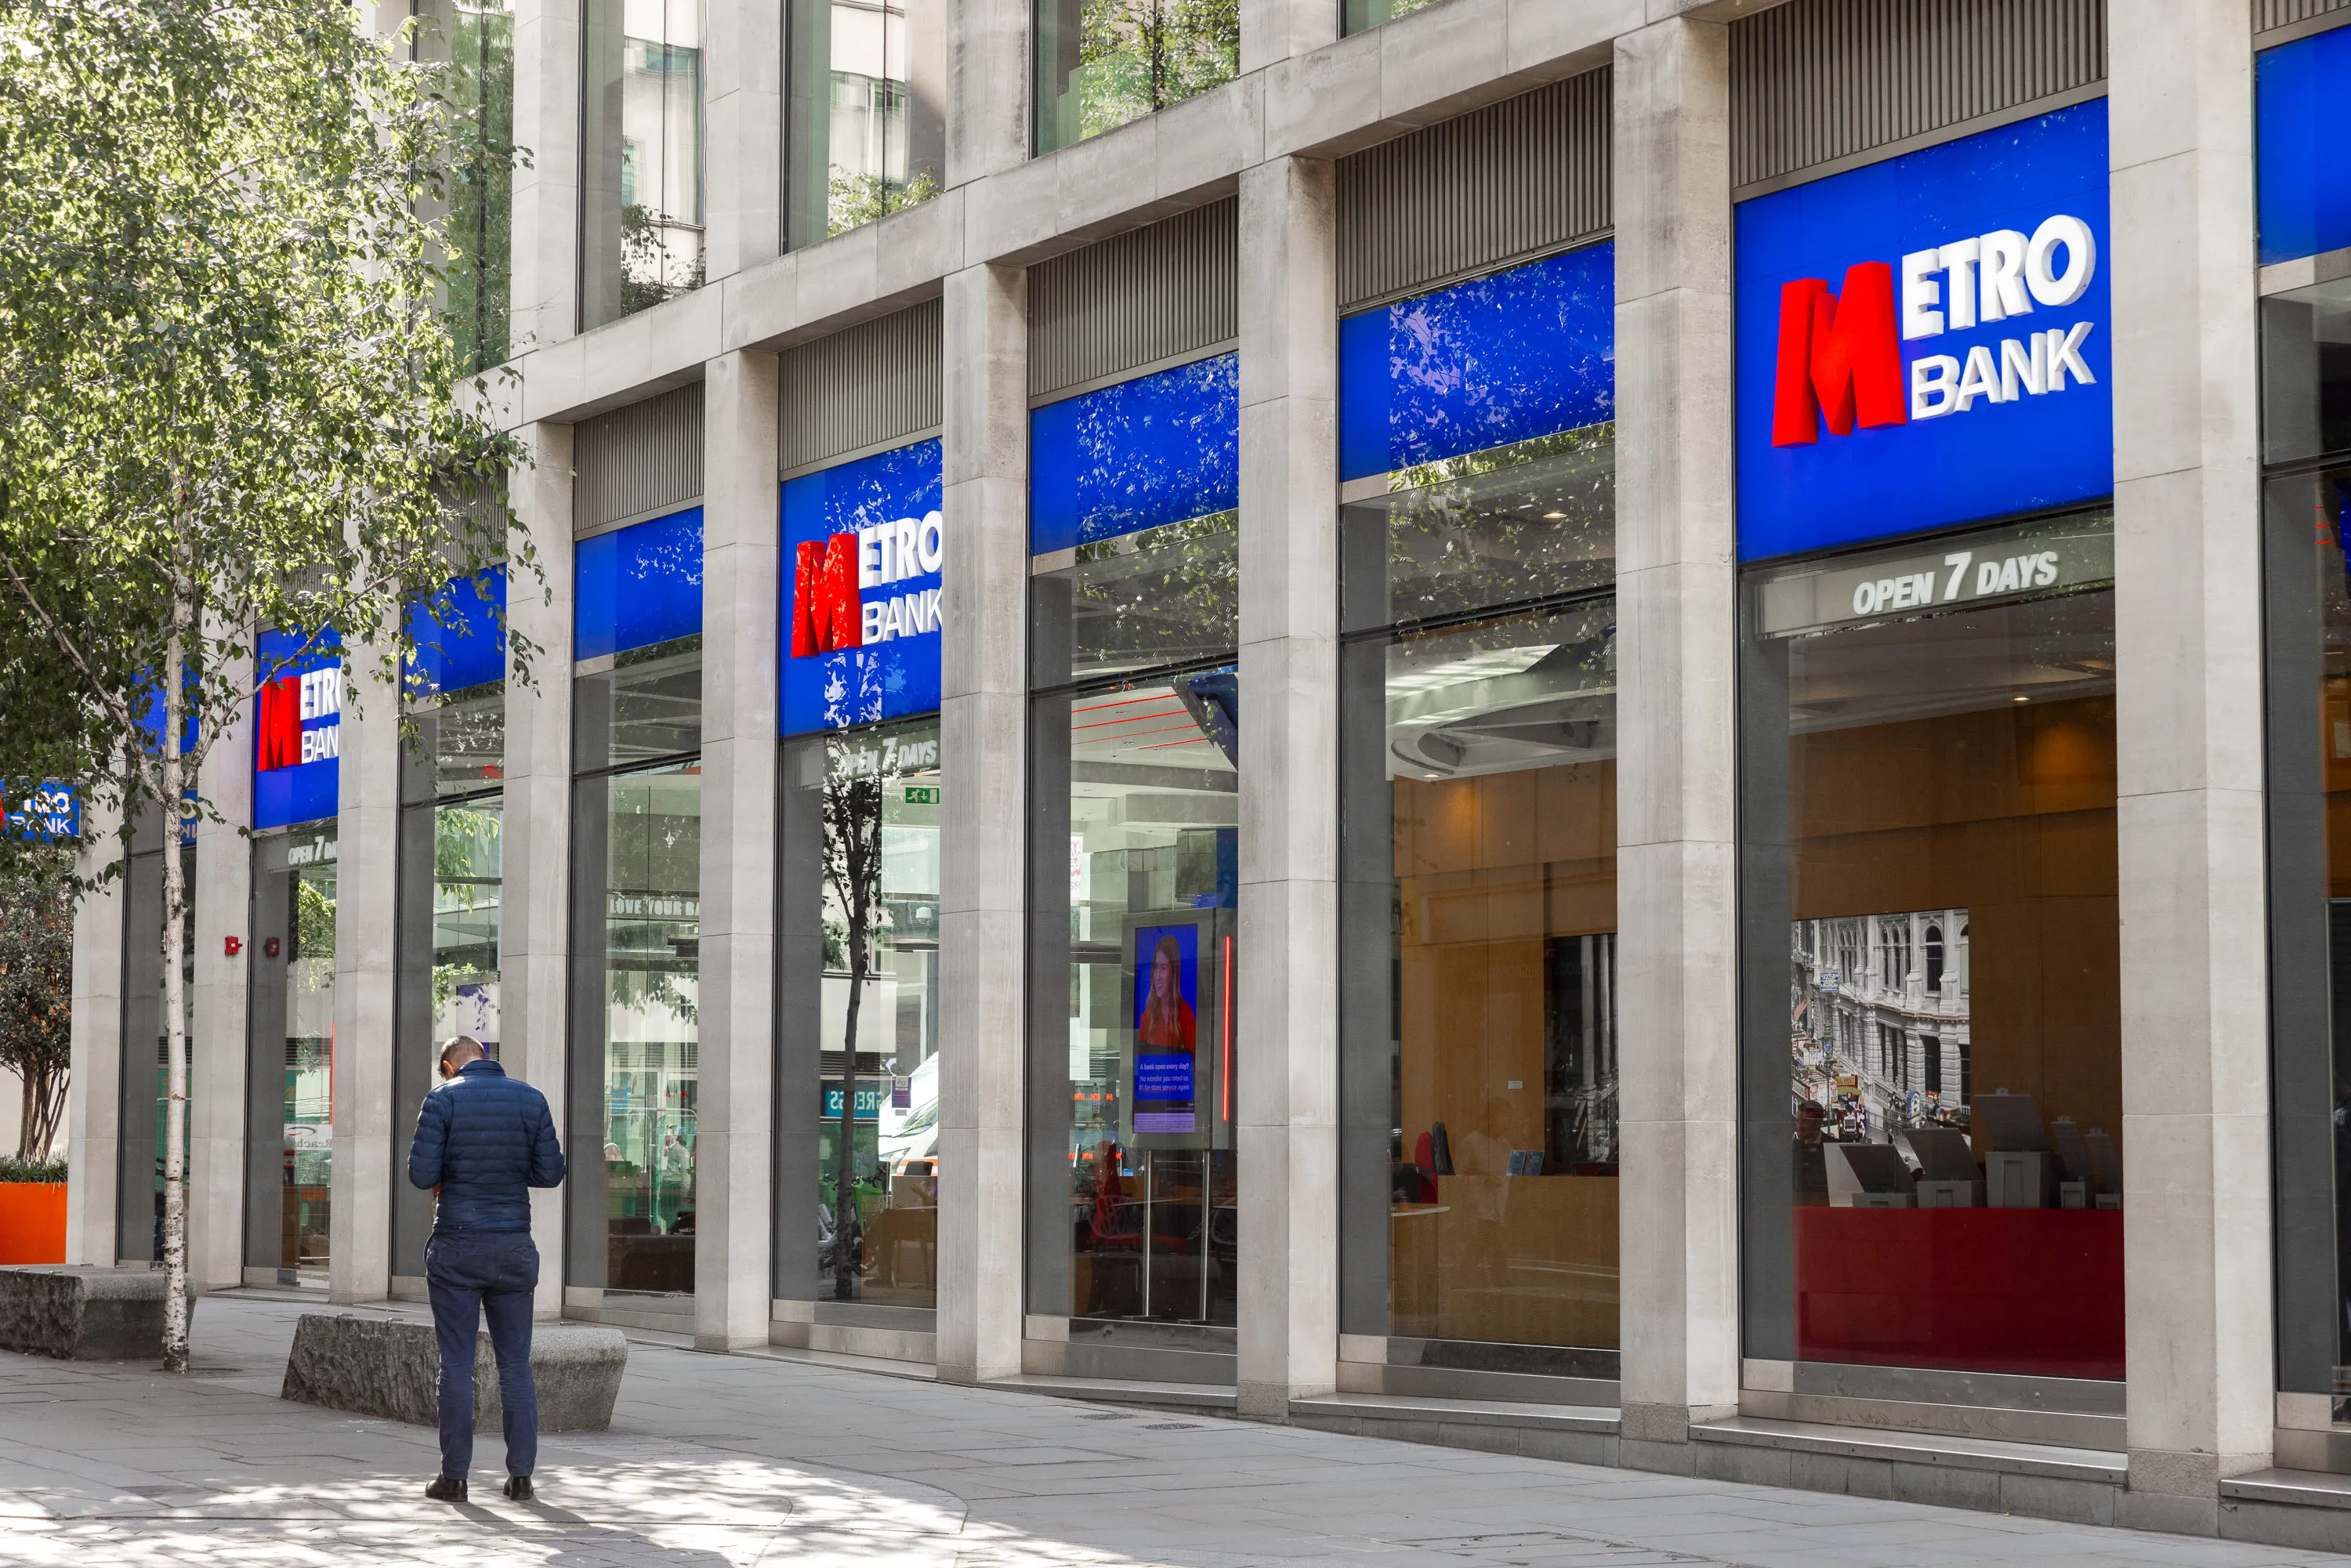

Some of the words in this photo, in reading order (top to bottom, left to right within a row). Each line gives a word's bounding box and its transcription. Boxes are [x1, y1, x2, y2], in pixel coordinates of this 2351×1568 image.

[1772, 214, 2097, 449] METRO
[1911, 321, 2097, 420] BANK
[791, 510, 943, 659] METRO
[1853, 571, 1935, 614] OPEN
[1943, 551, 1972, 601] 7
[1976, 551, 2059, 595] DAYS
[862, 587, 942, 646] BANK
[302, 724, 339, 764] BAN
[882, 737, 898, 770] 7
[897, 740, 937, 768] DAYS
[314, 835, 325, 861] 7
[609, 897, 642, 914] LOVE
[647, 899, 682, 915] YOUR
